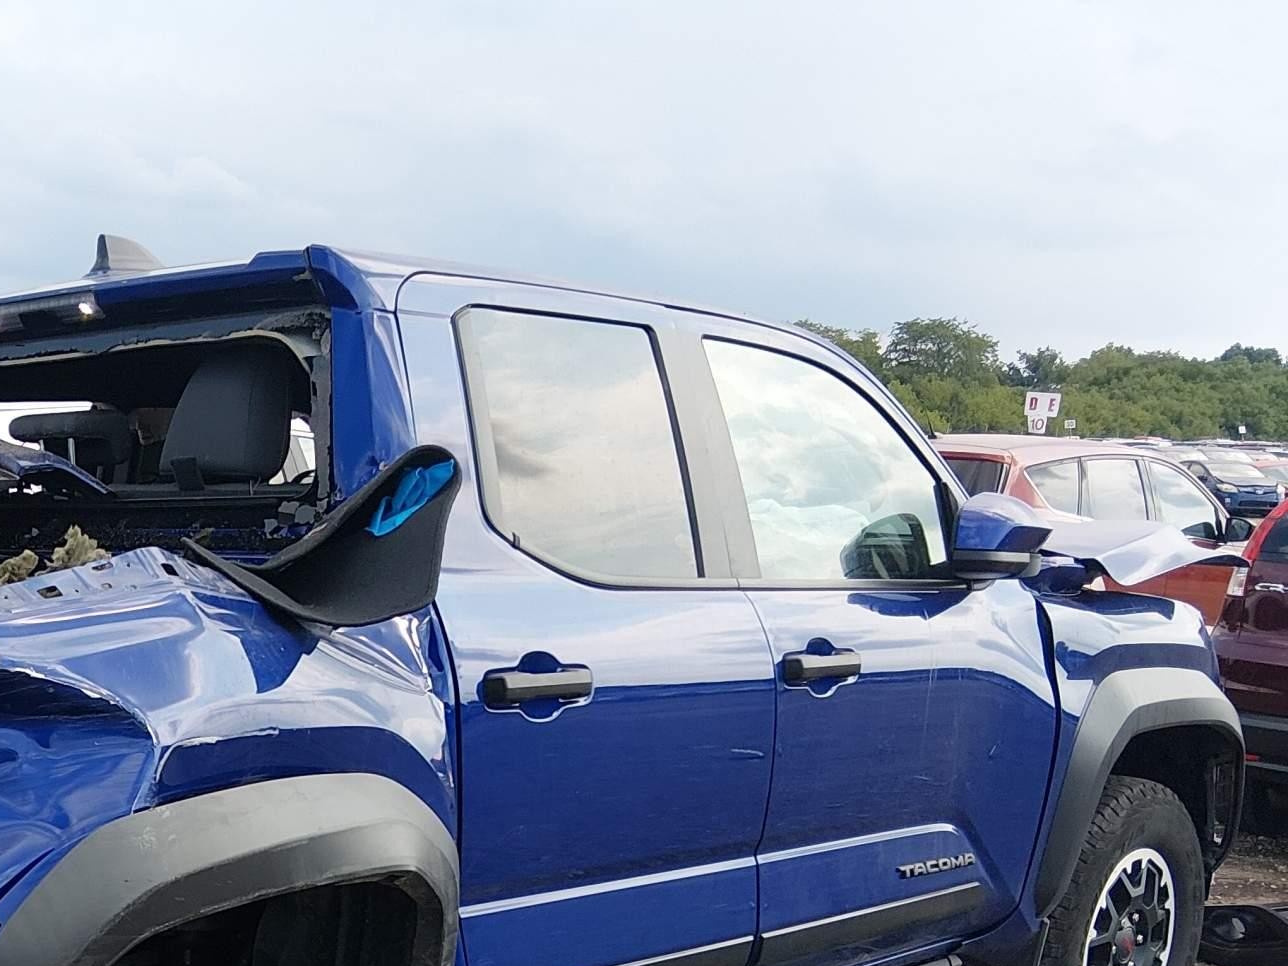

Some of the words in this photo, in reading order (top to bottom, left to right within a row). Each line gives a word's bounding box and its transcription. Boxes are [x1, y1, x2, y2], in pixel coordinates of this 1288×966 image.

[1029, 397, 1038, 411] D
[1048, 398, 1056, 412] E
[1031, 418, 1045, 430] 10
[898, 853, 976, 878] TACOMA
